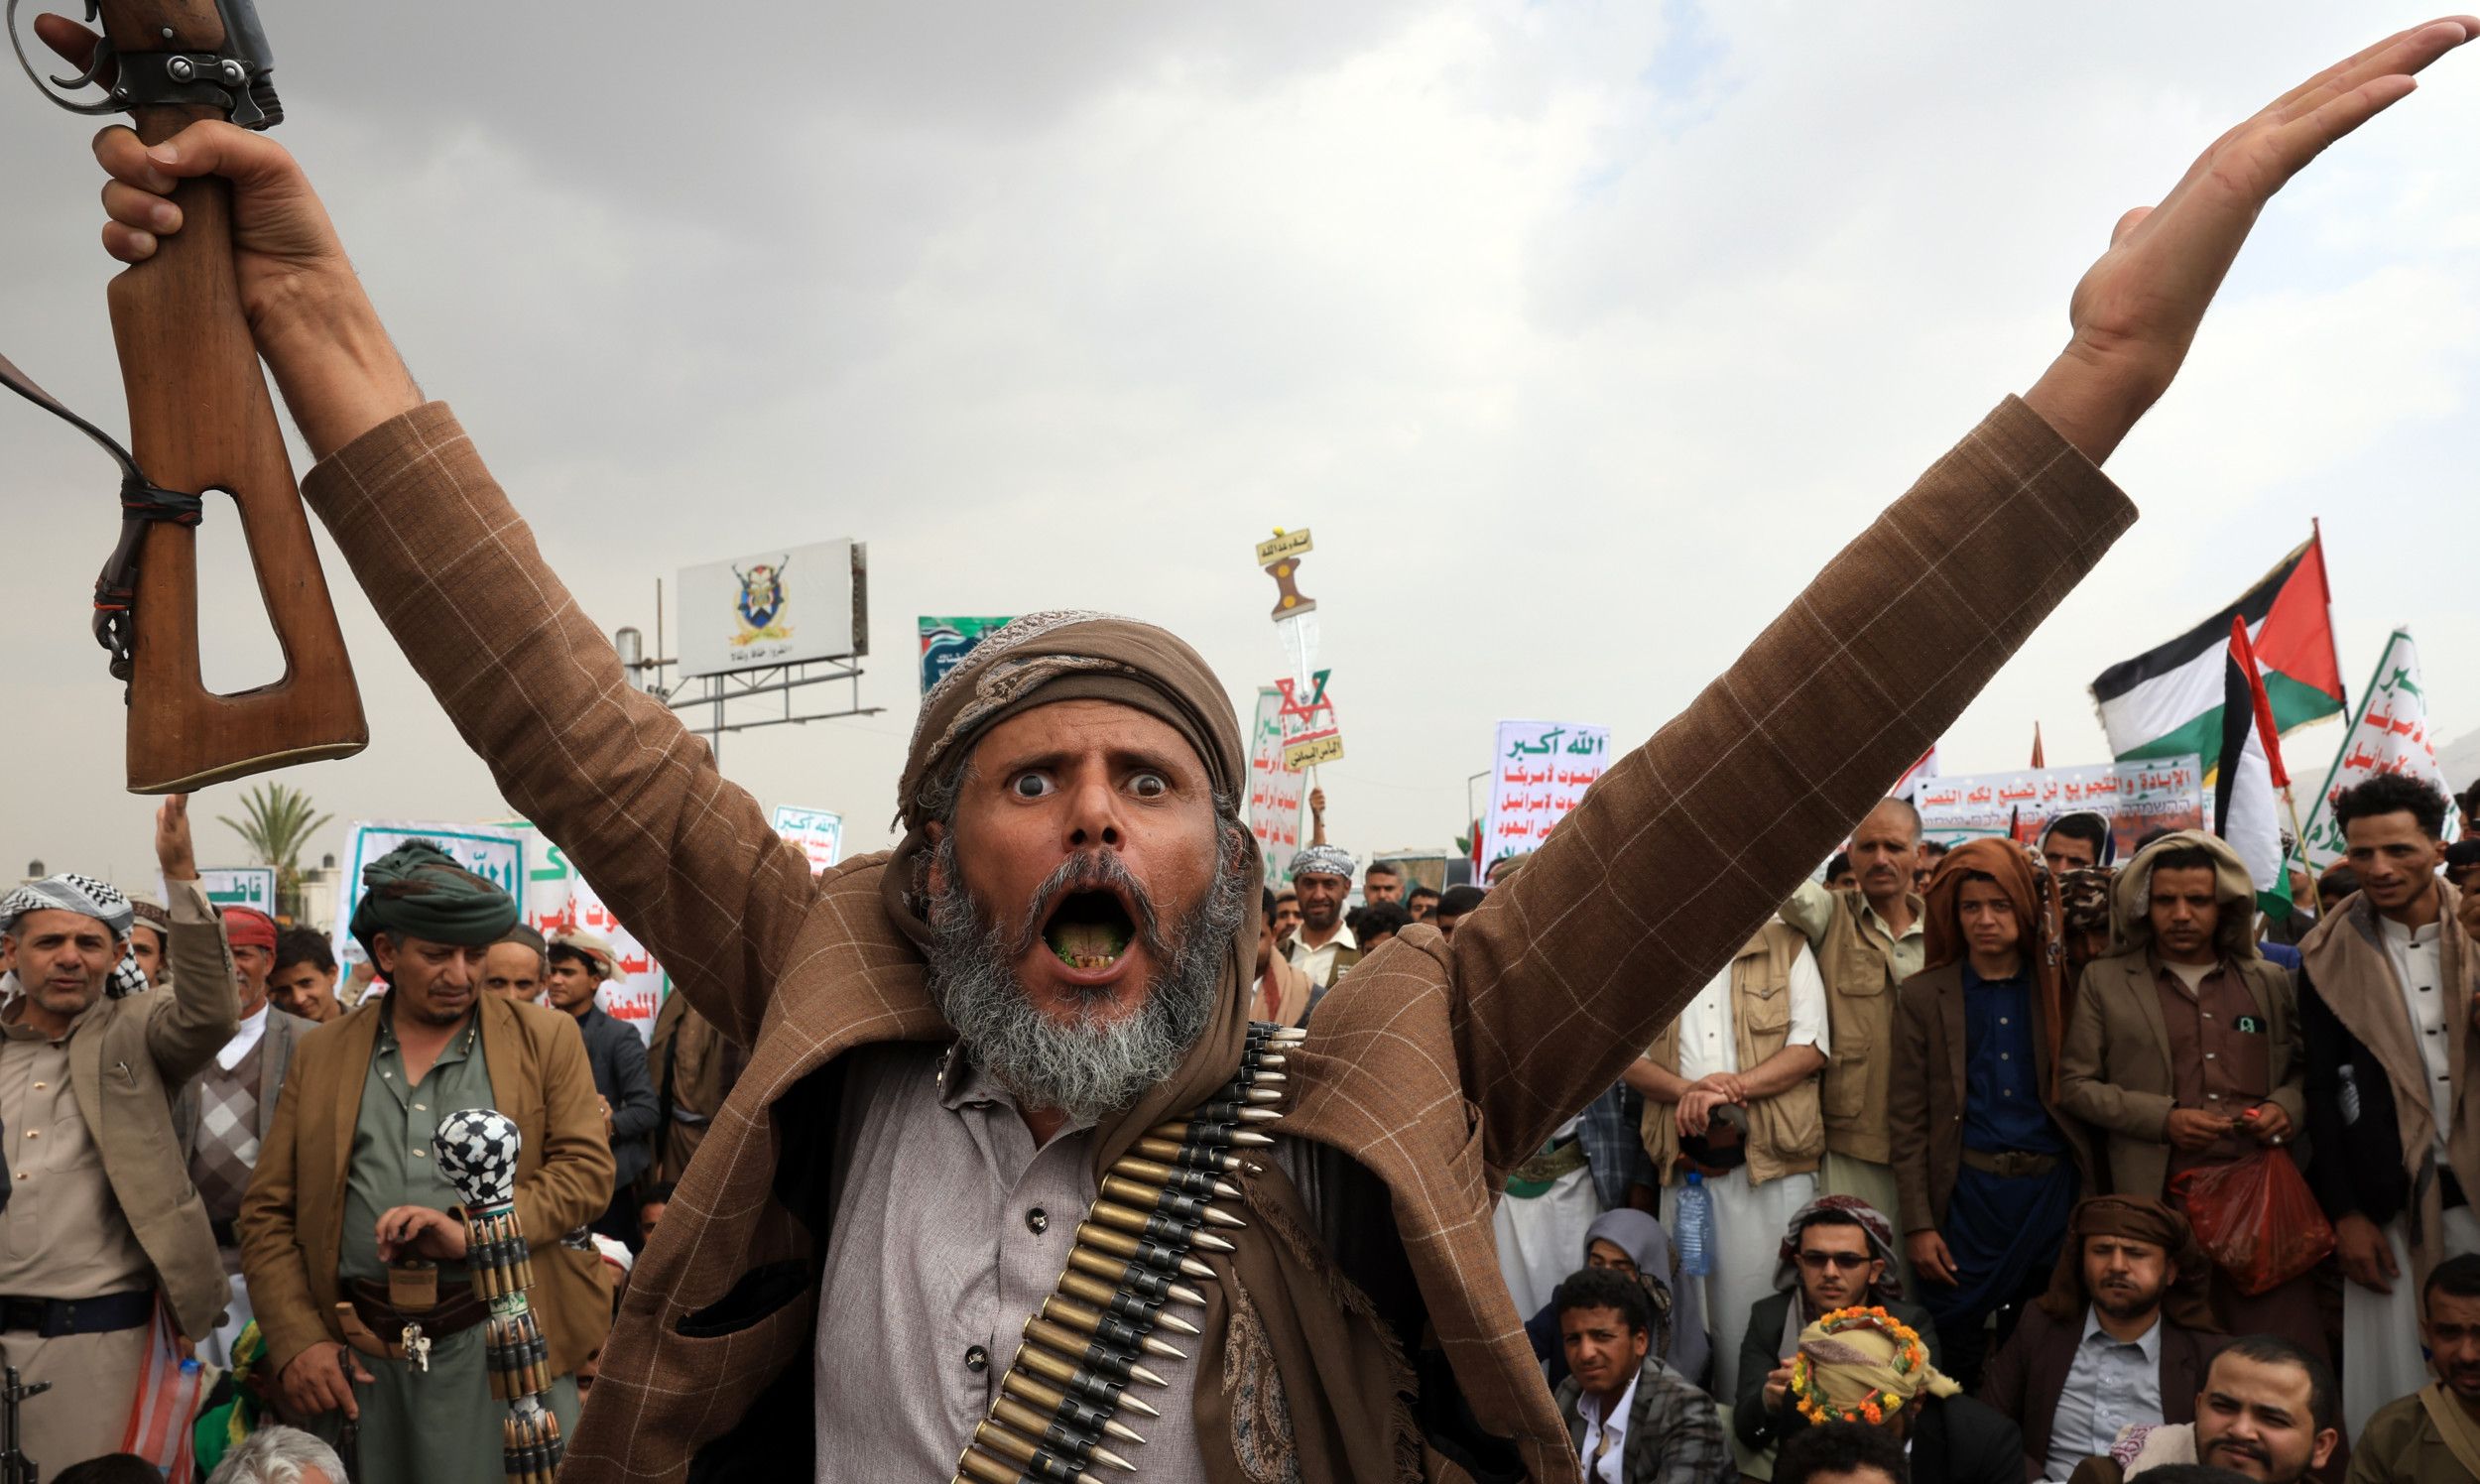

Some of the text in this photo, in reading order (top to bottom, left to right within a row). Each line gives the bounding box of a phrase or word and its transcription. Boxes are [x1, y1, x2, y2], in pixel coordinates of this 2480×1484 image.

[1506, 726, 1604, 762] الله أكبر
[1504, 763, 1554, 787] لأمريكا
[1921, 789, 1962, 809] النصر
[1967, 786, 1991, 804] لكم
[1998, 782, 2037, 807] تصنع
[2043, 780, 2058, 802] لن
[1498, 818, 1535, 839] اليهود
[607, 990, 658, 1020] اللعنة
